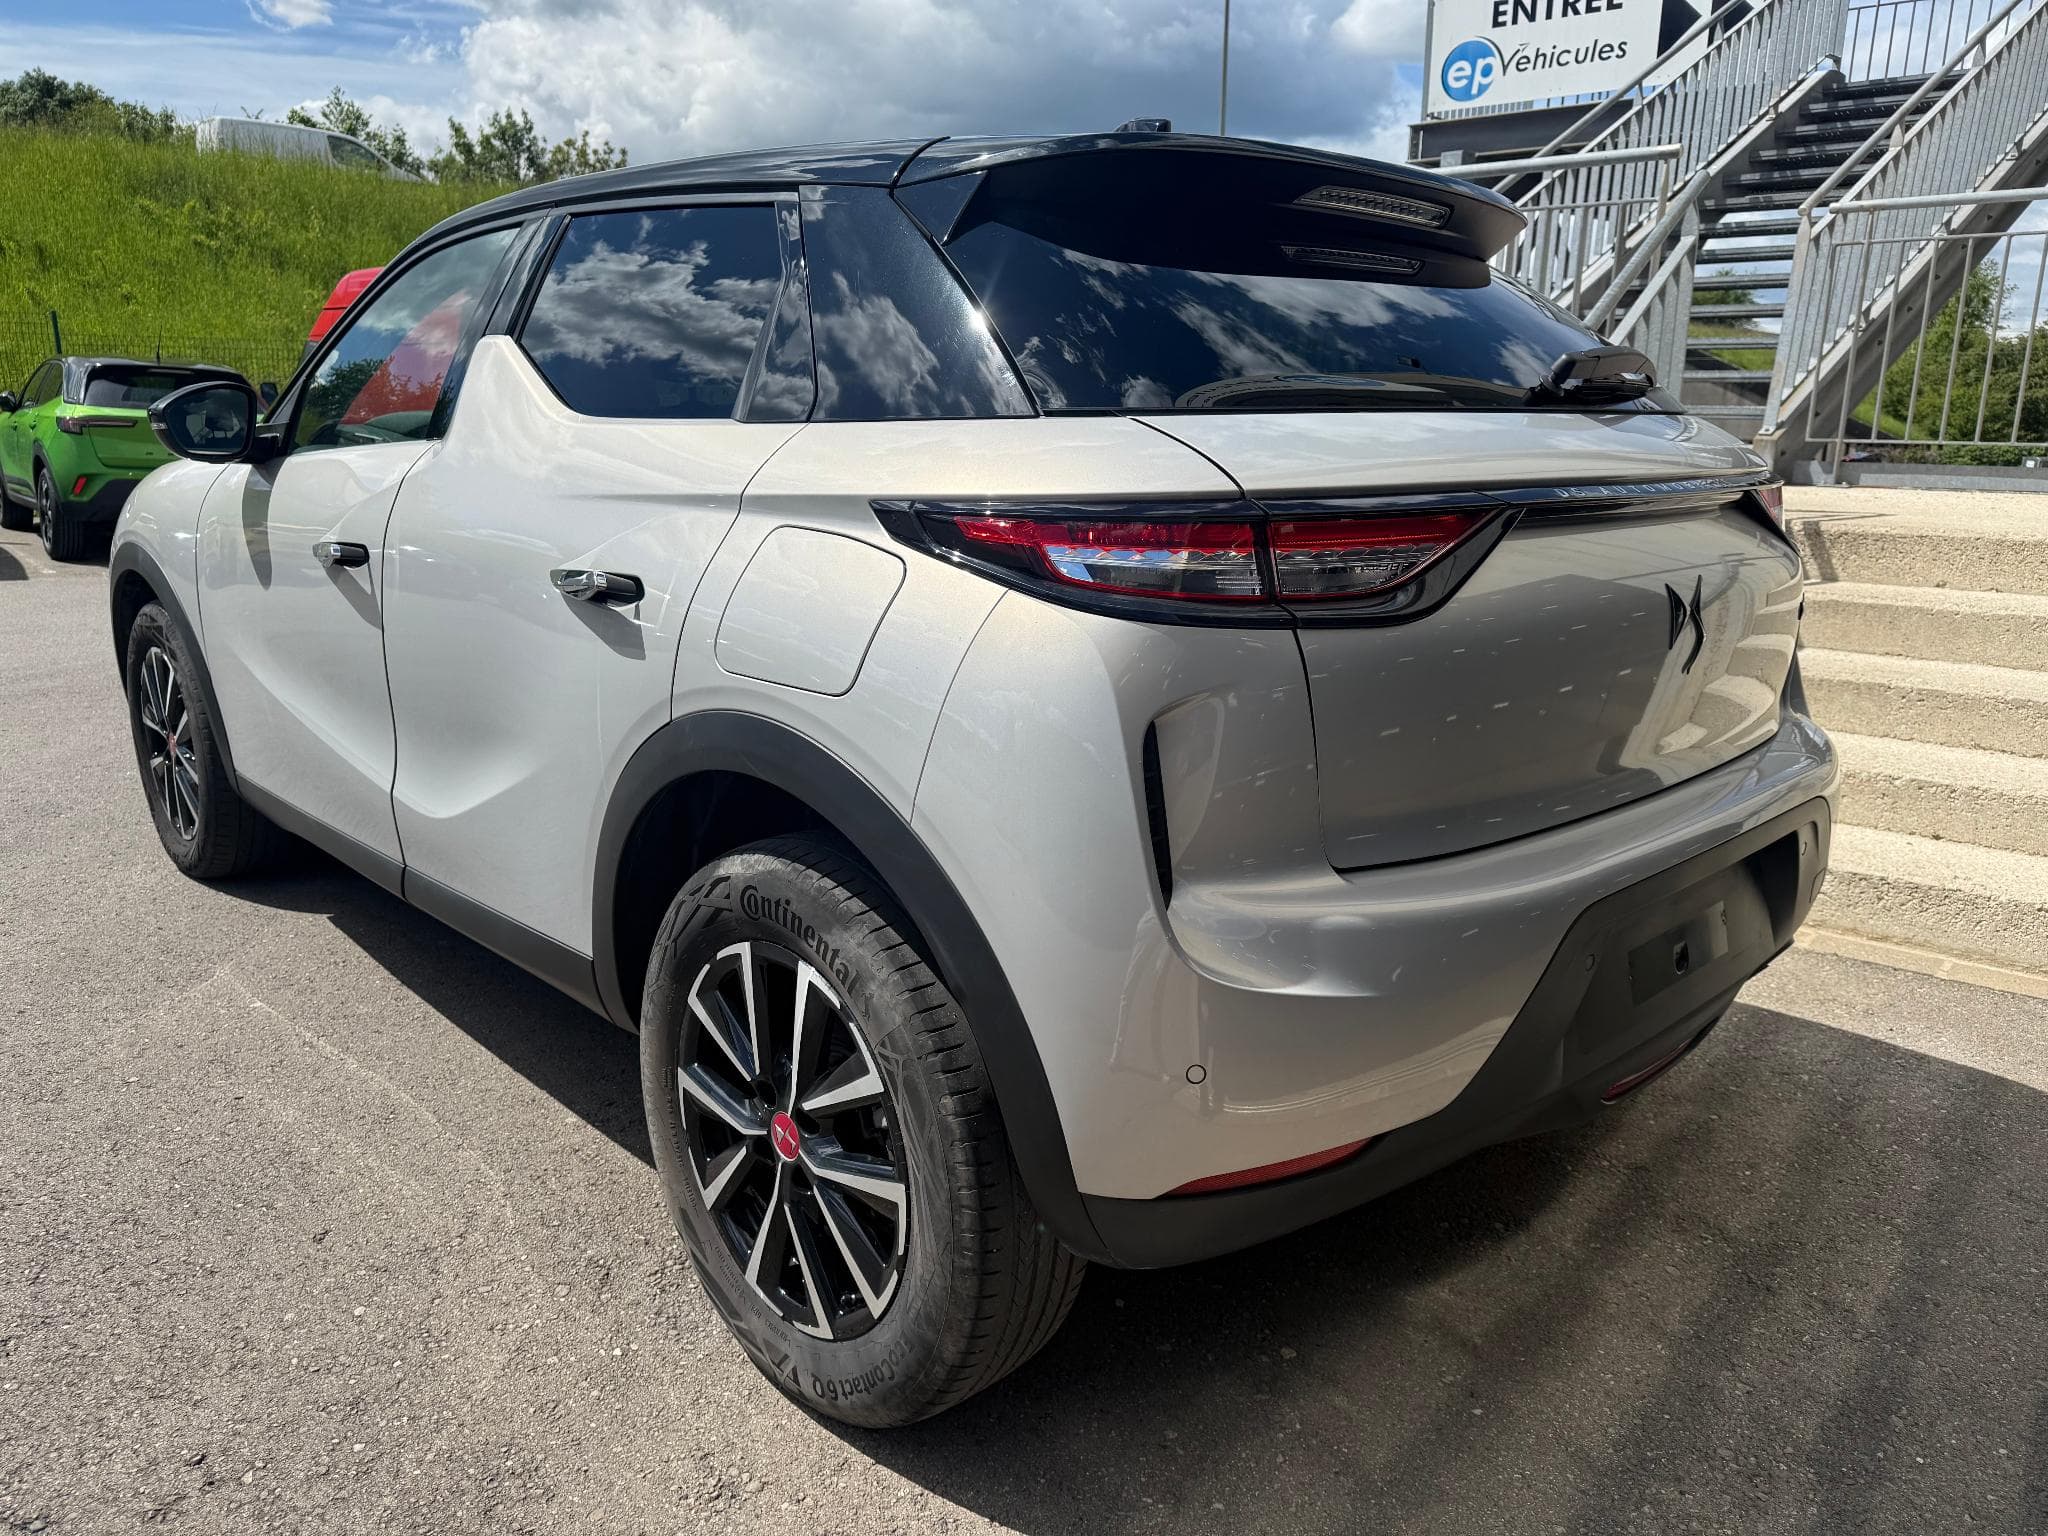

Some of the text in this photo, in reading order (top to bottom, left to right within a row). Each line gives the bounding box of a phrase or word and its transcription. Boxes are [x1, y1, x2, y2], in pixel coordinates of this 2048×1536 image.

[1600, 478, 1728, 496] AUTOMO
[741, 884, 860, 993] Continental
[826, 1379, 839, 1401] 6
